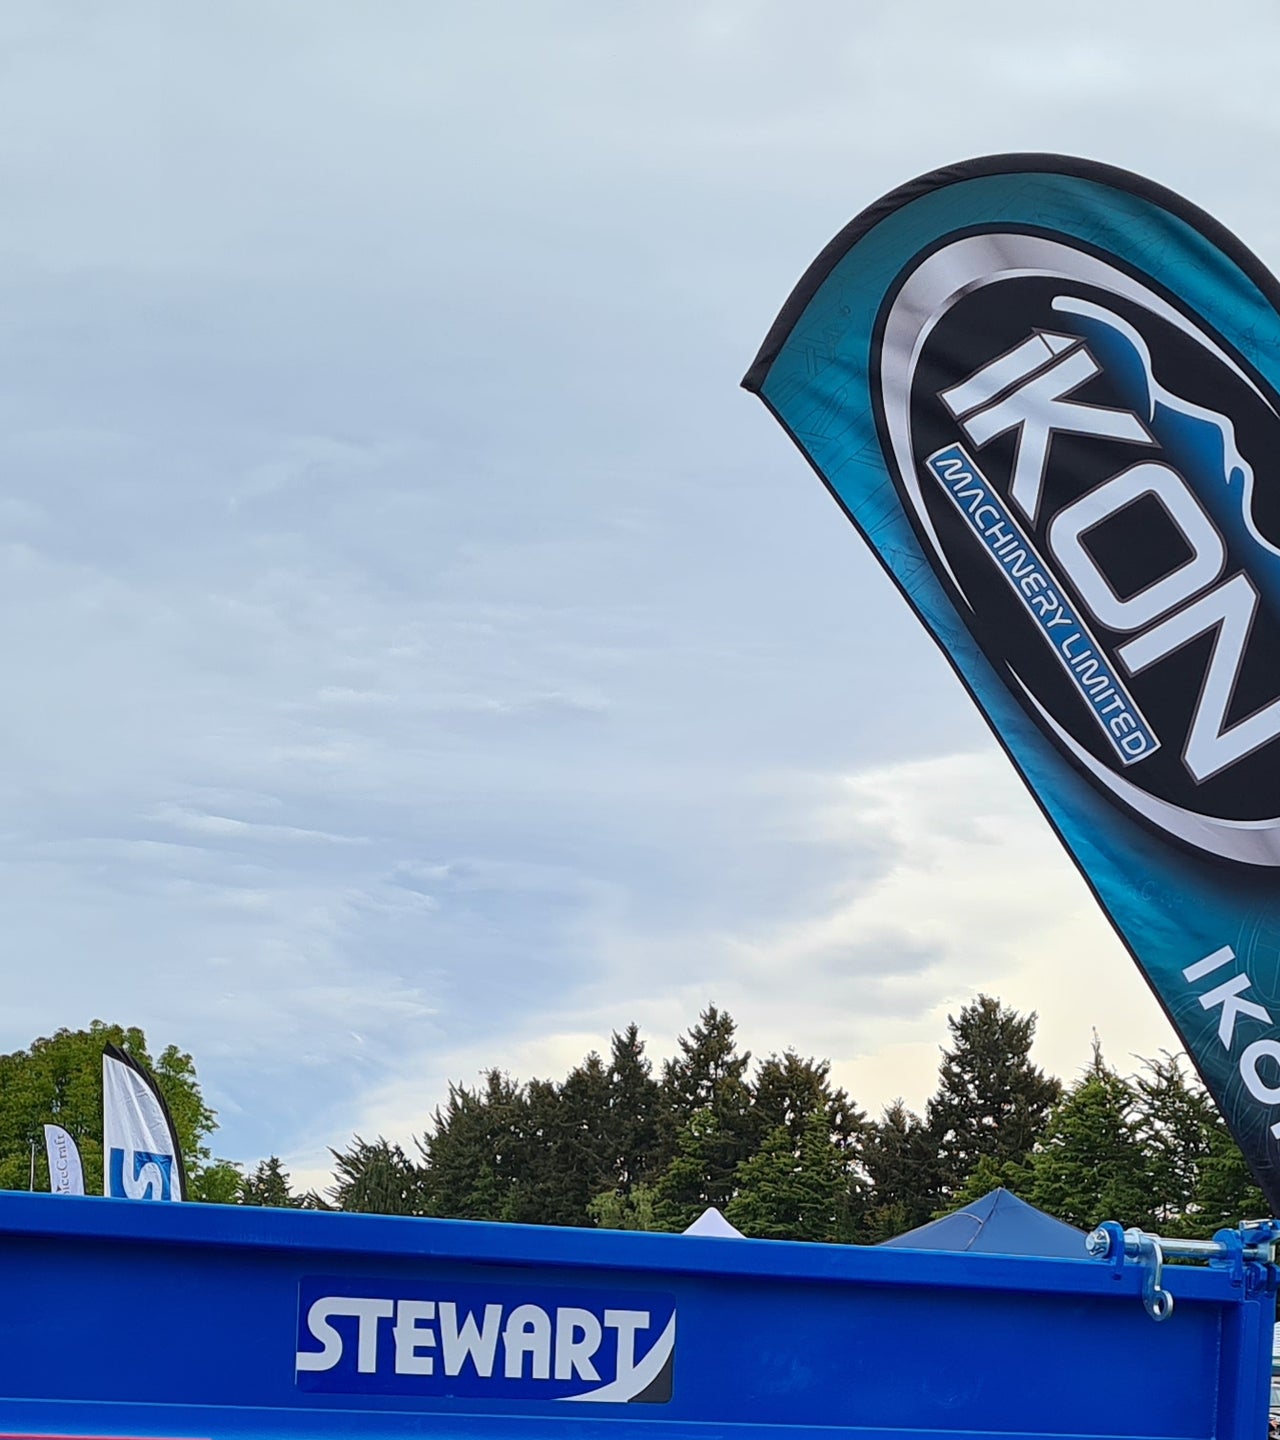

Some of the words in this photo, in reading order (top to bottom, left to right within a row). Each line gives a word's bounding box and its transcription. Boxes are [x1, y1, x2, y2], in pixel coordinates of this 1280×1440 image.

[935, 453, 1073, 628] MACHINERY
[1061, 634, 1150, 758] LIMITED
[296, 1296, 677, 1404] STEWART
